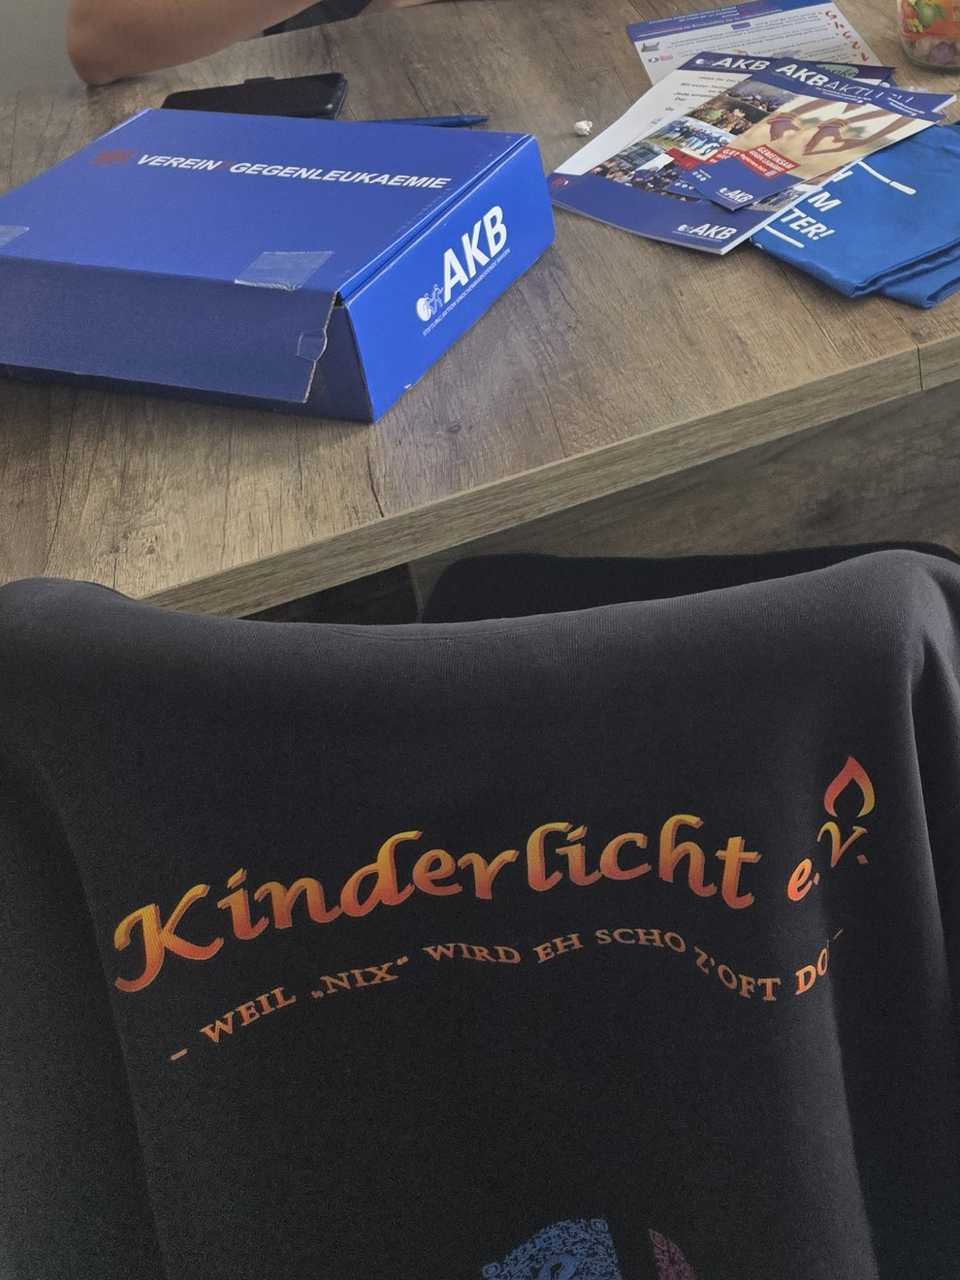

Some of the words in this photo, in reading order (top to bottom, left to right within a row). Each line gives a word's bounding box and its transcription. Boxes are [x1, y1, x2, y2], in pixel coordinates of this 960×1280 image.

[711, 57, 770, 71] AKB
[775, 63, 829, 86] AKB
[137, 153, 223, 171] VEREIN
[229, 162, 451, 189] GEGENLEUKAEMIE
[689, 223, 737, 240] AKB
[444, 205, 507, 305] AKB
[114, 814, 762, 993] Kinderlicht
[200, 986, 297, 1044] WEIL
[422, 942, 521, 964] WIRD
[534, 933, 584, 963] EH
[595, 927, 687, 953] SCHO
